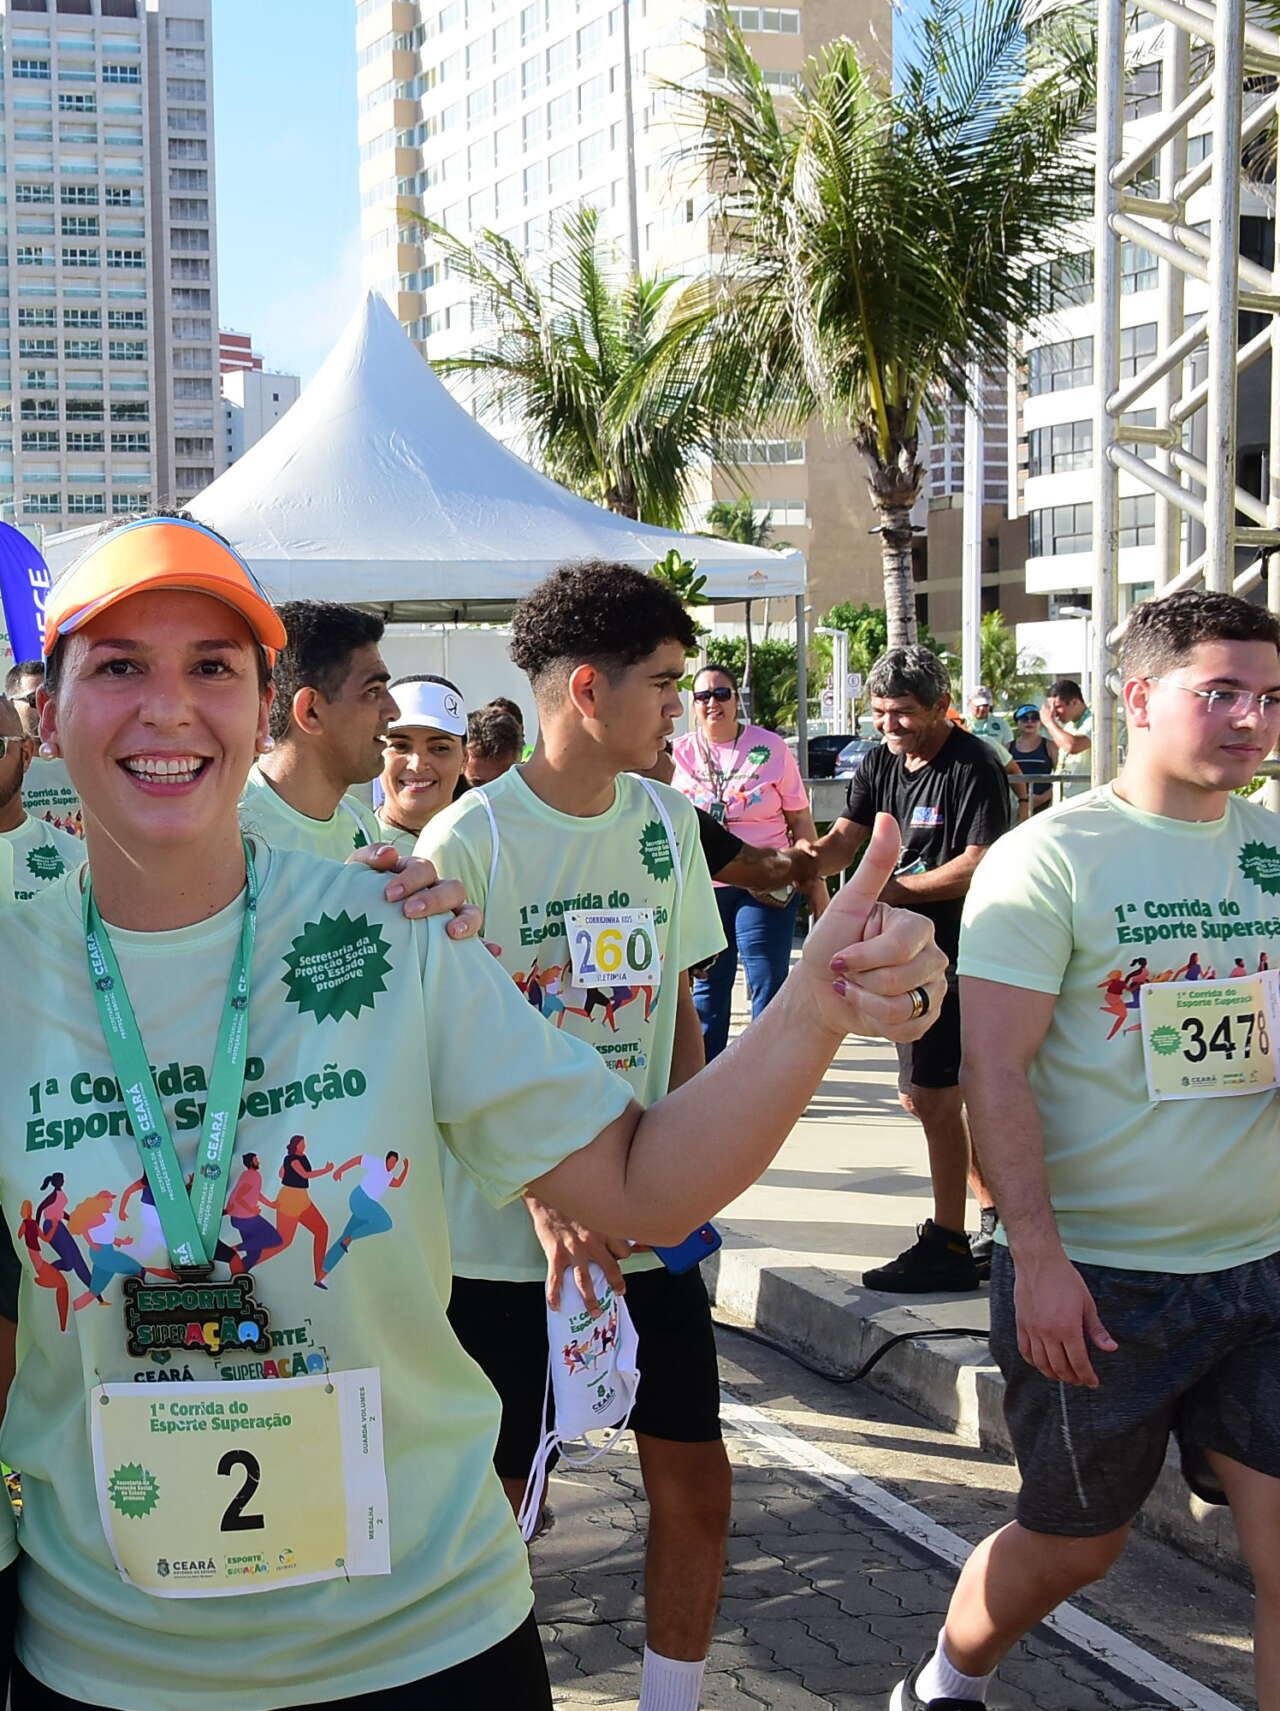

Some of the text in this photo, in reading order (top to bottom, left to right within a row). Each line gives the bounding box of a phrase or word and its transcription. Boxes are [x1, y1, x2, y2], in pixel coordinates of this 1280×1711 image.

[22, 796, 79, 809] sporte Super
[27, 788, 59, 799] Corrida
[520, 904, 539, 925] 1ª
[608, 889, 630, 908] do
[1114, 898, 1240, 923] 1ª Corrida do
[1116, 916, 1280, 945] Esporte Superaçã
[299, 936, 370, 967] Secretaria da
[345, 943, 378, 962] Social
[576, 927, 653, 974] 260
[311, 958, 365, 984] do Estado
[28, 1077, 59, 1115] 1ª
[70, 1063, 209, 1104] Coida
[25, 1062, 367, 1152] Espor Seração
[126, 1083, 150, 1131] CEARÁ
[206, 1111, 224, 1160] CEARÁ
[136, 1289, 242, 1311] ESPORTE
[136, 1316, 260, 1351] SUPERAÇÃO
[134, 1364, 194, 1382] CEARÁ
[150, 1401, 249, 1417] 1ª Corrida do
[150, 1413, 292, 1435] Esporte Superação
[217, 1449, 265, 1533] 2
[172, 1557, 216, 1571] CEARÁ
[227, 1554, 262, 1565] ESPORTE
